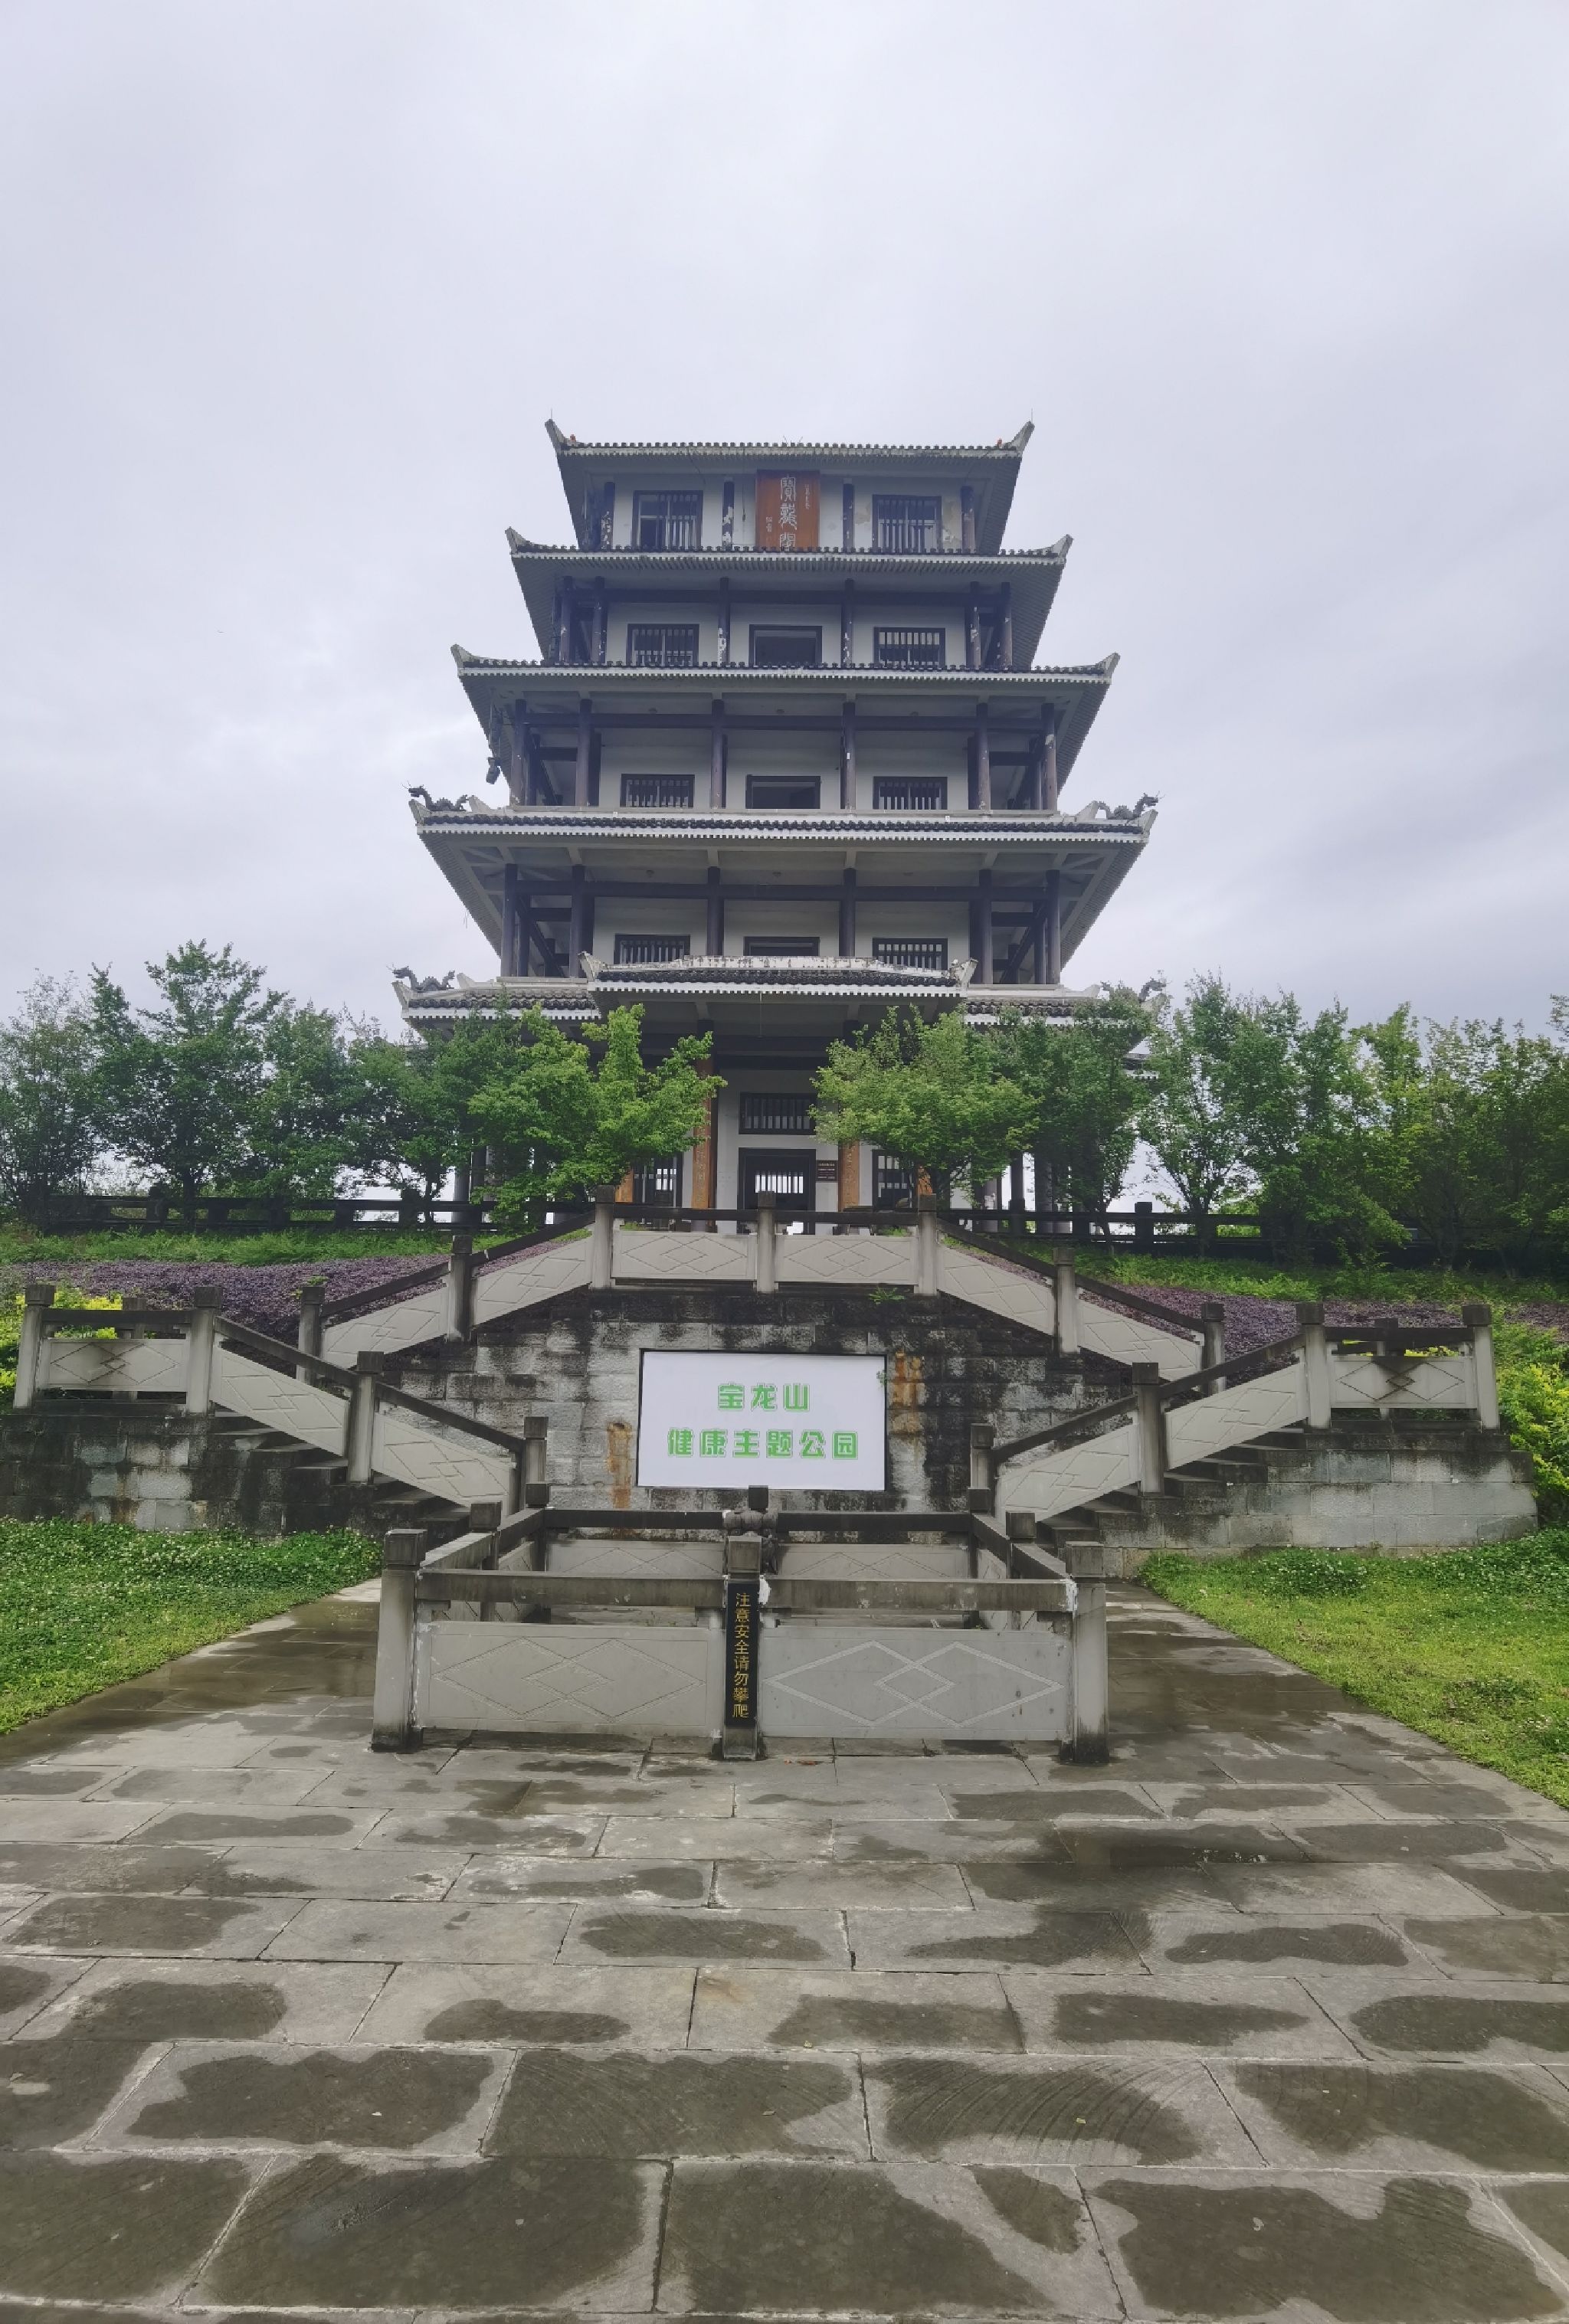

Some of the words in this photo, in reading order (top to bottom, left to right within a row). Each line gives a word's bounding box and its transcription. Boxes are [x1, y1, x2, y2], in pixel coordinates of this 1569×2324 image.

[717, 1382, 810, 1411] 宝龙山
[667, 1427, 859, 1460] 健康主题公园
[732, 1592, 751, 1718] 注意安全请勿攀爬
